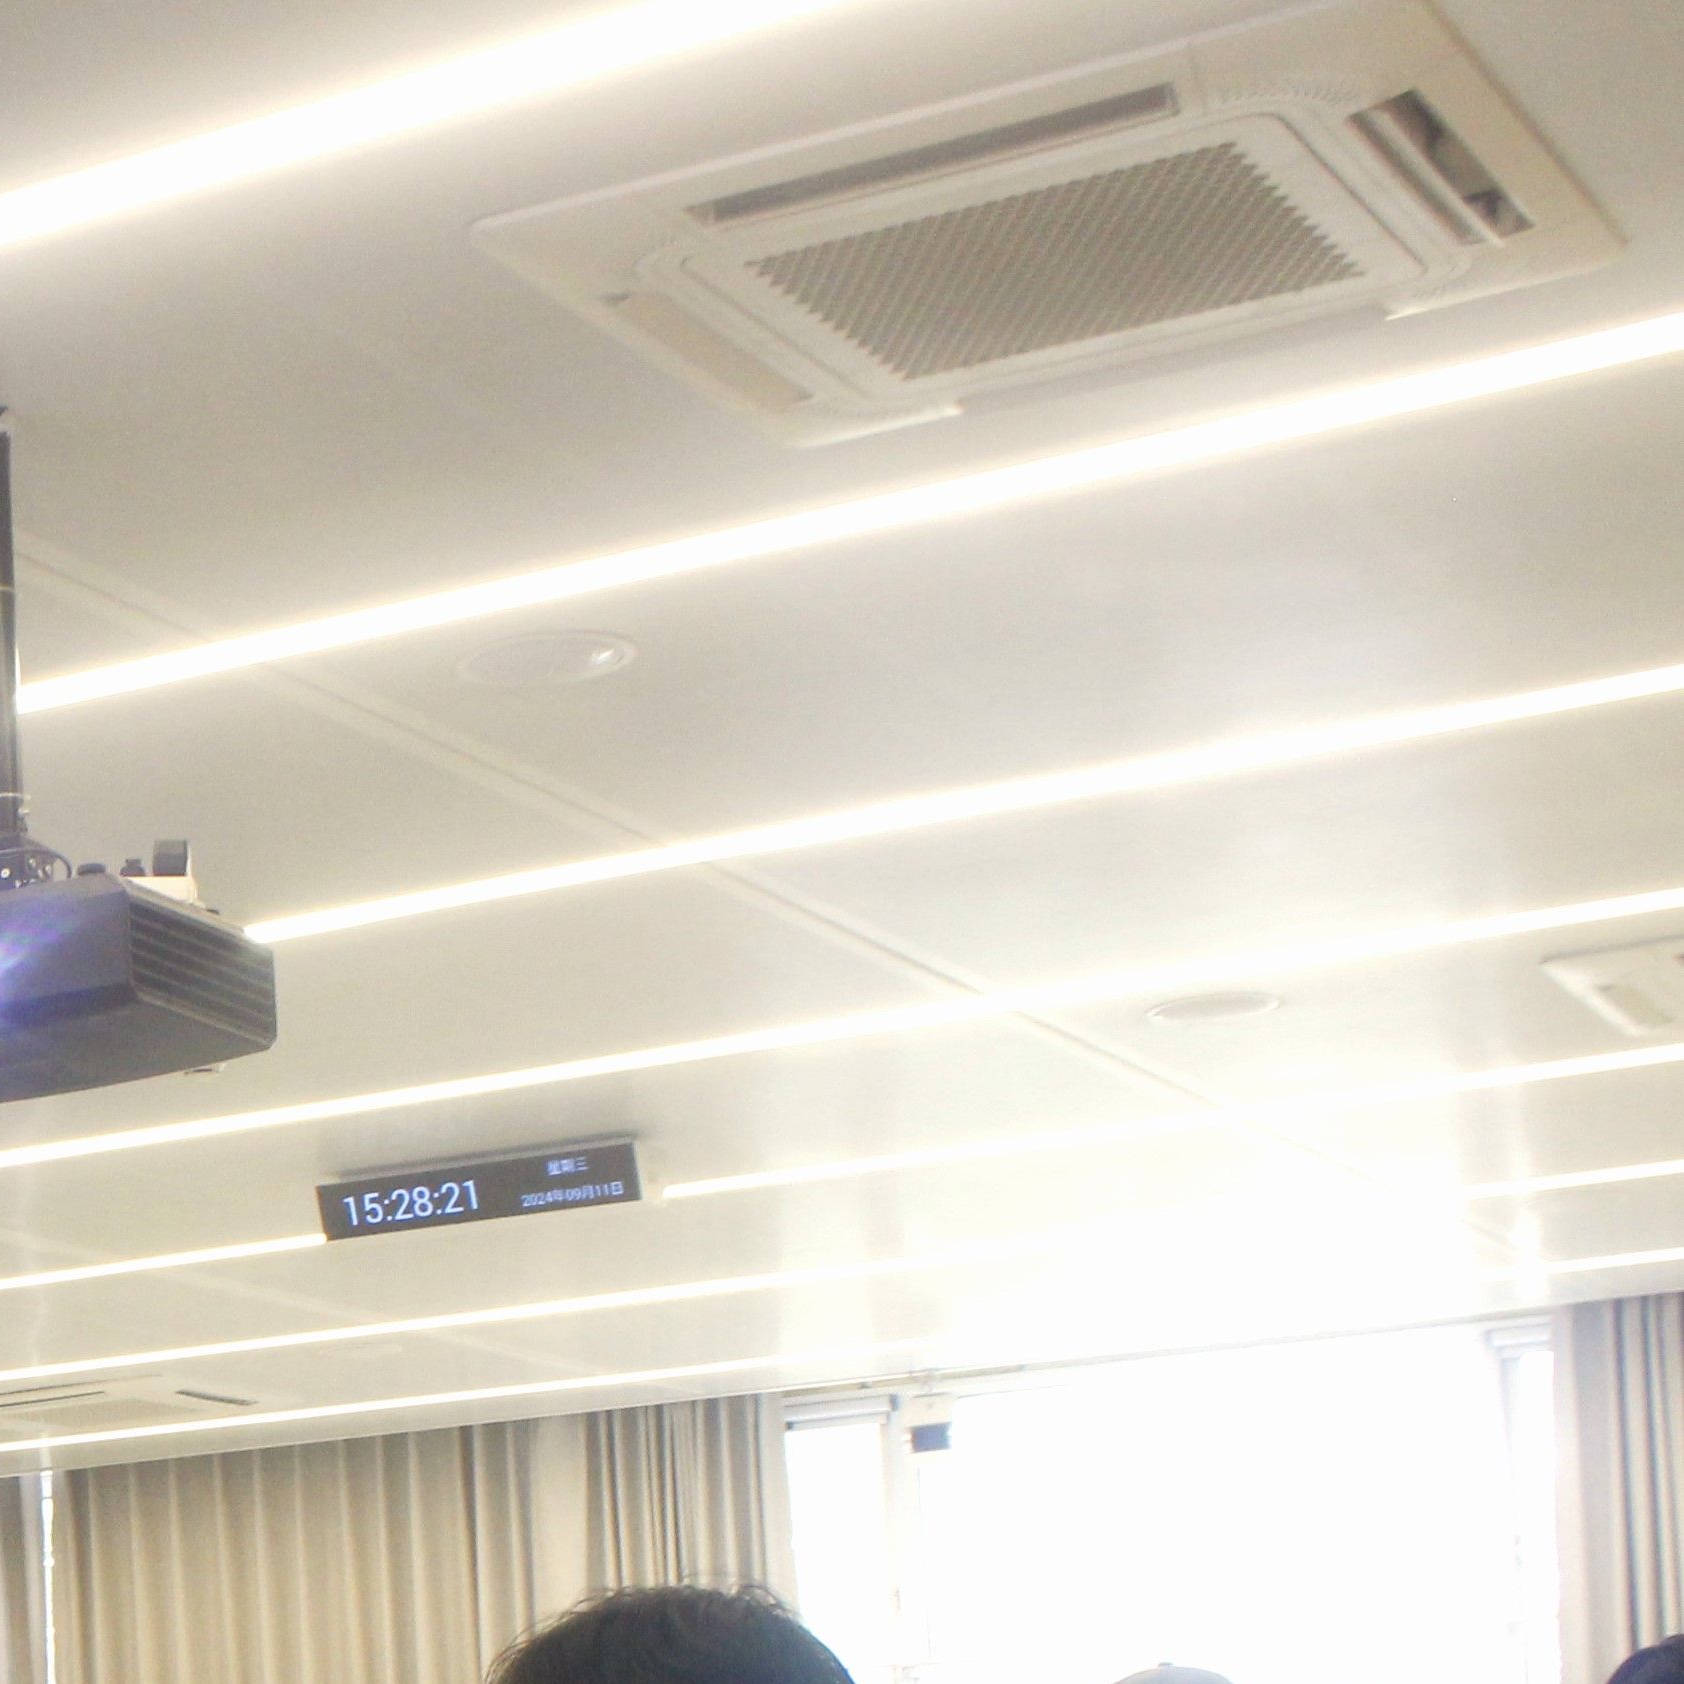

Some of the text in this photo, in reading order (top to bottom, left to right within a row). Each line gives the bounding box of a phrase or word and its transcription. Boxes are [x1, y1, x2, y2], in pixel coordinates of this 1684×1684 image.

[343, 1179, 480, 1226] 15:28:21
[521, 1181, 625, 1208] 2024年09月11日
